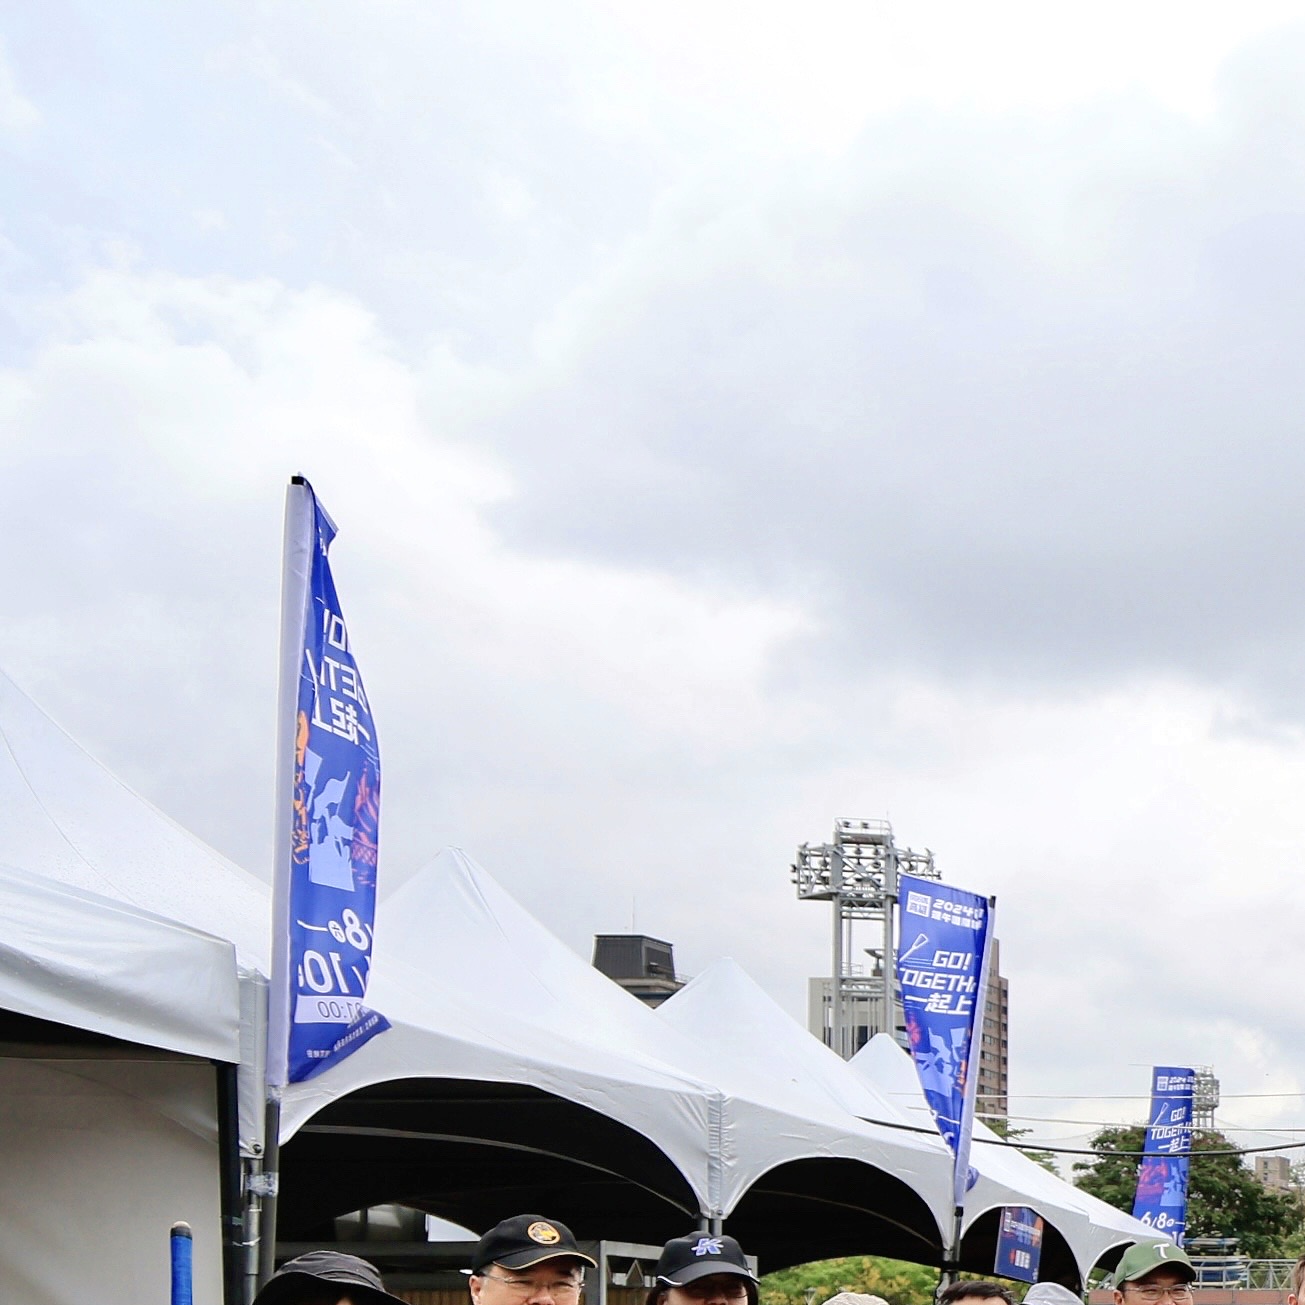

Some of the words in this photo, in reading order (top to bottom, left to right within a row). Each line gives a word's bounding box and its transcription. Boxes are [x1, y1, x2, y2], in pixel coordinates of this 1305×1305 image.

[933, 951, 972, 970] GO!
[905, 993, 972, 1015] 一起上
